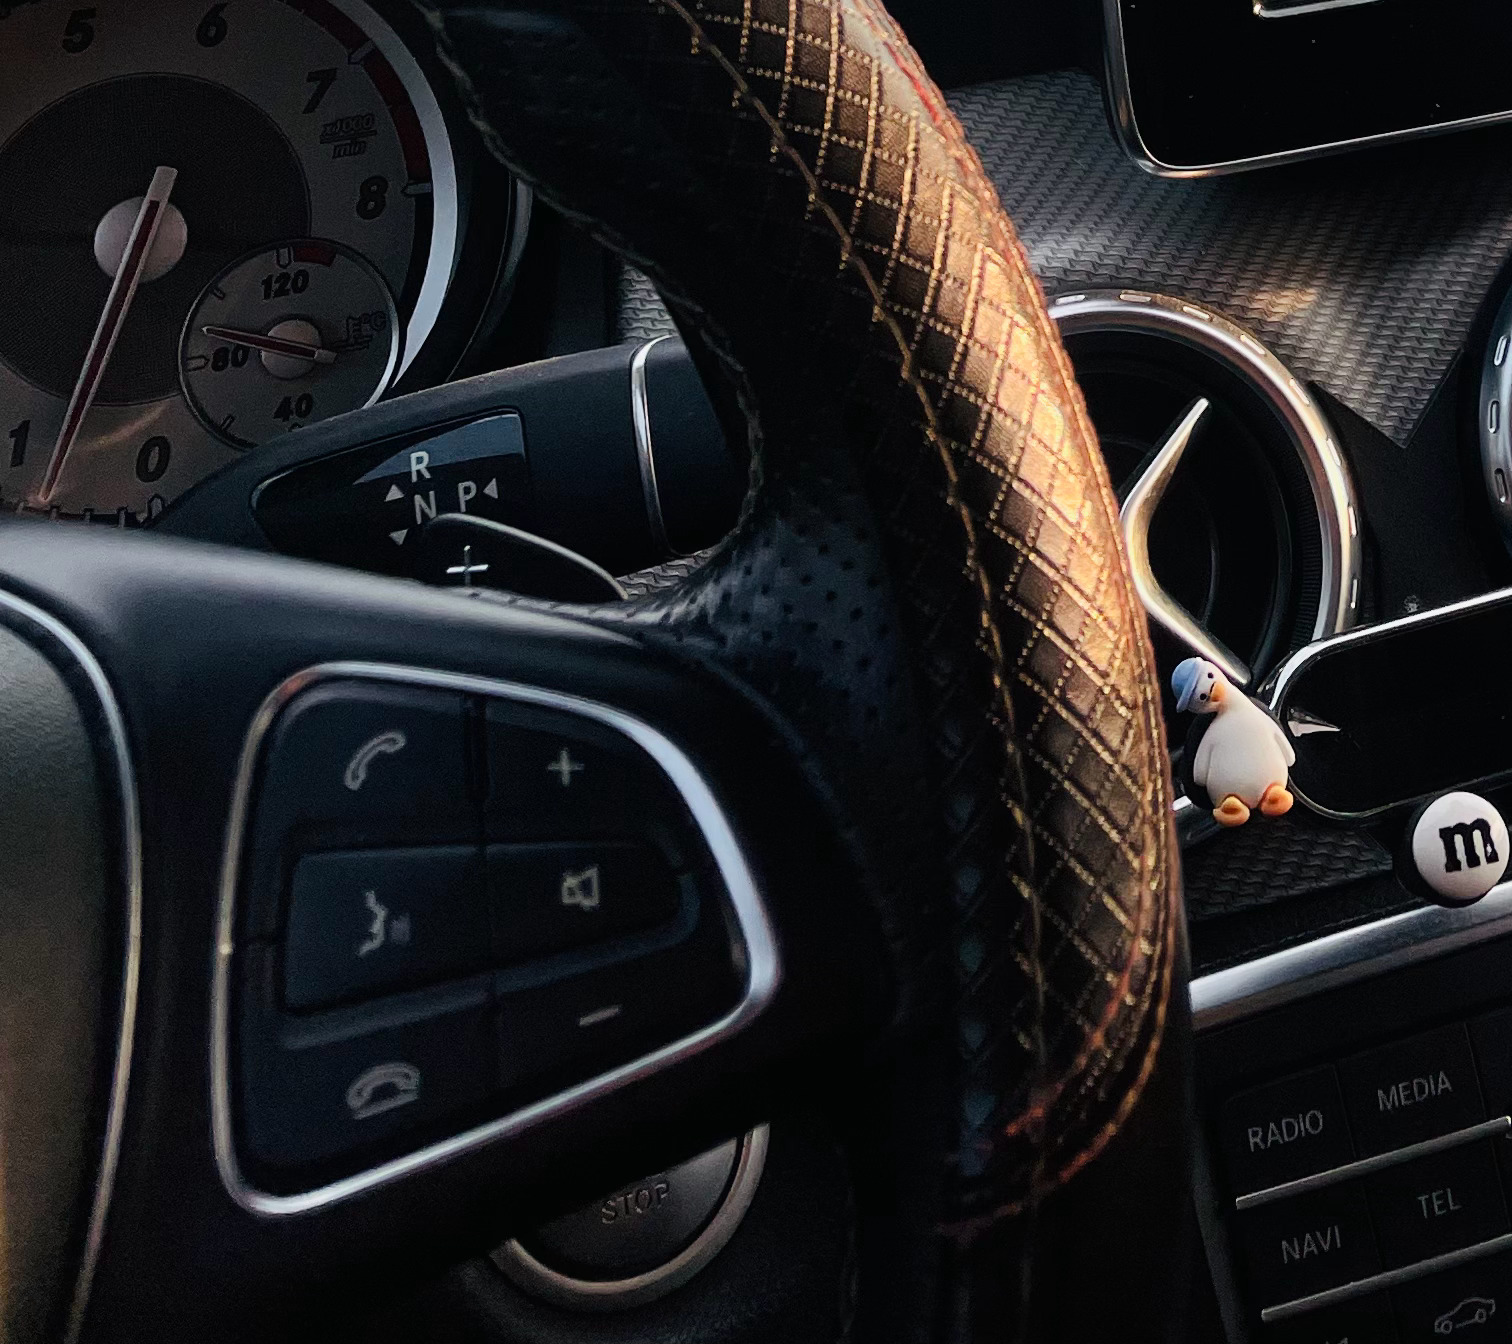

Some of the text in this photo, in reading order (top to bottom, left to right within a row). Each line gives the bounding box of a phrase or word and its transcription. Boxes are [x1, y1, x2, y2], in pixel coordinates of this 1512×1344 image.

[62, 8, 97, 54] 5
[195, 3, 229, 49] 6
[303, 68, 339, 115] 7
[331, 138, 368, 160] min
[355, 175, 390, 221] 8
[261, 271, 311, 301] 120
[210, 347, 250, 373] 80
[273, 392, 315, 424] 40
[8, 419, 32, 469] 1
[136, 436, 171, 484] 0
[410, 450, 432, 484] R
[413, 490, 438, 525] N
[457, 480, 478, 513] P
[1438, 816, 1500, 874] m
[1376, 1069, 1454, 1113] MEDIA
[1246, 1109, 1325, 1153] RADIO
[600, 1179, 672, 1225] STOP
[1416, 1187, 1463, 1220] TEL
[1280, 1224, 1342, 1265] NAVI
